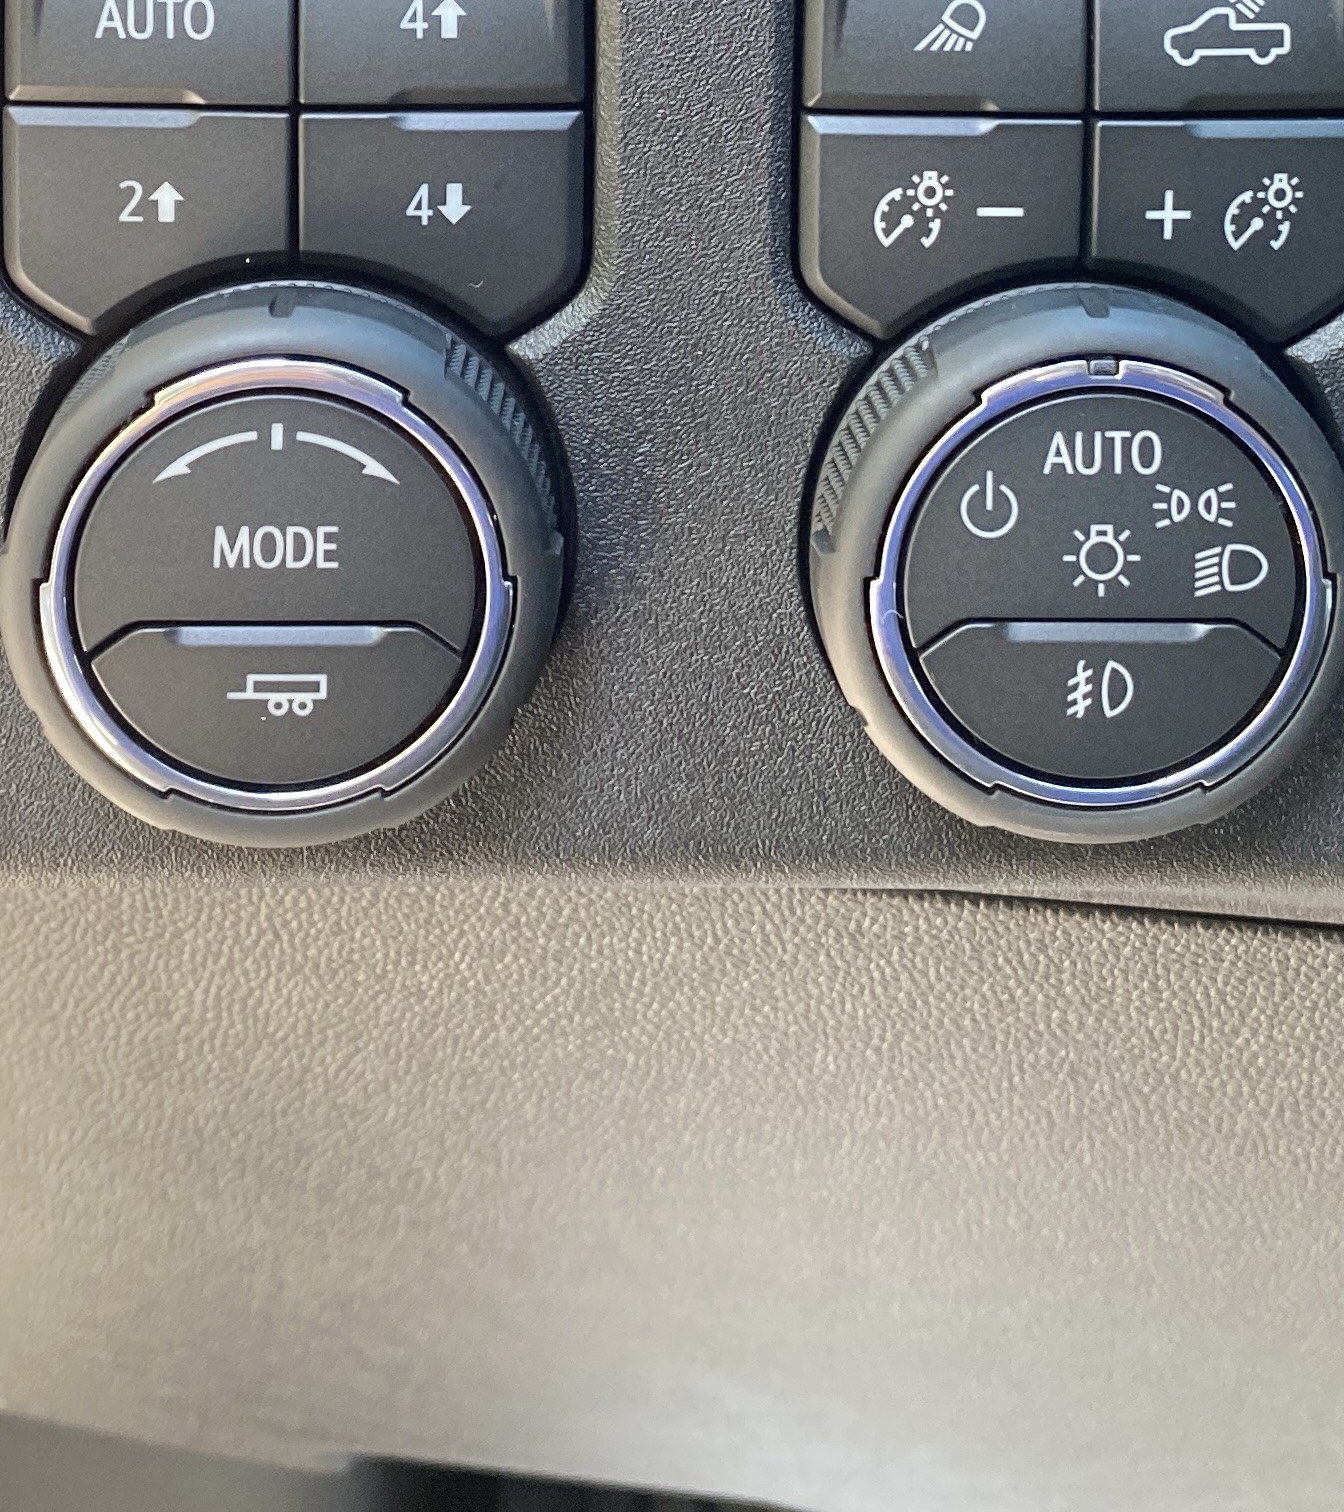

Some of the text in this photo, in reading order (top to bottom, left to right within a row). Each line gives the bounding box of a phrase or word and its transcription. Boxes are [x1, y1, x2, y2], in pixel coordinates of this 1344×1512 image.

[117, 179, 145, 223] 2
[404, 182, 435, 227] 4
[1041, 429, 1163, 477] AUTO
[212, 524, 340, 570] MODE
